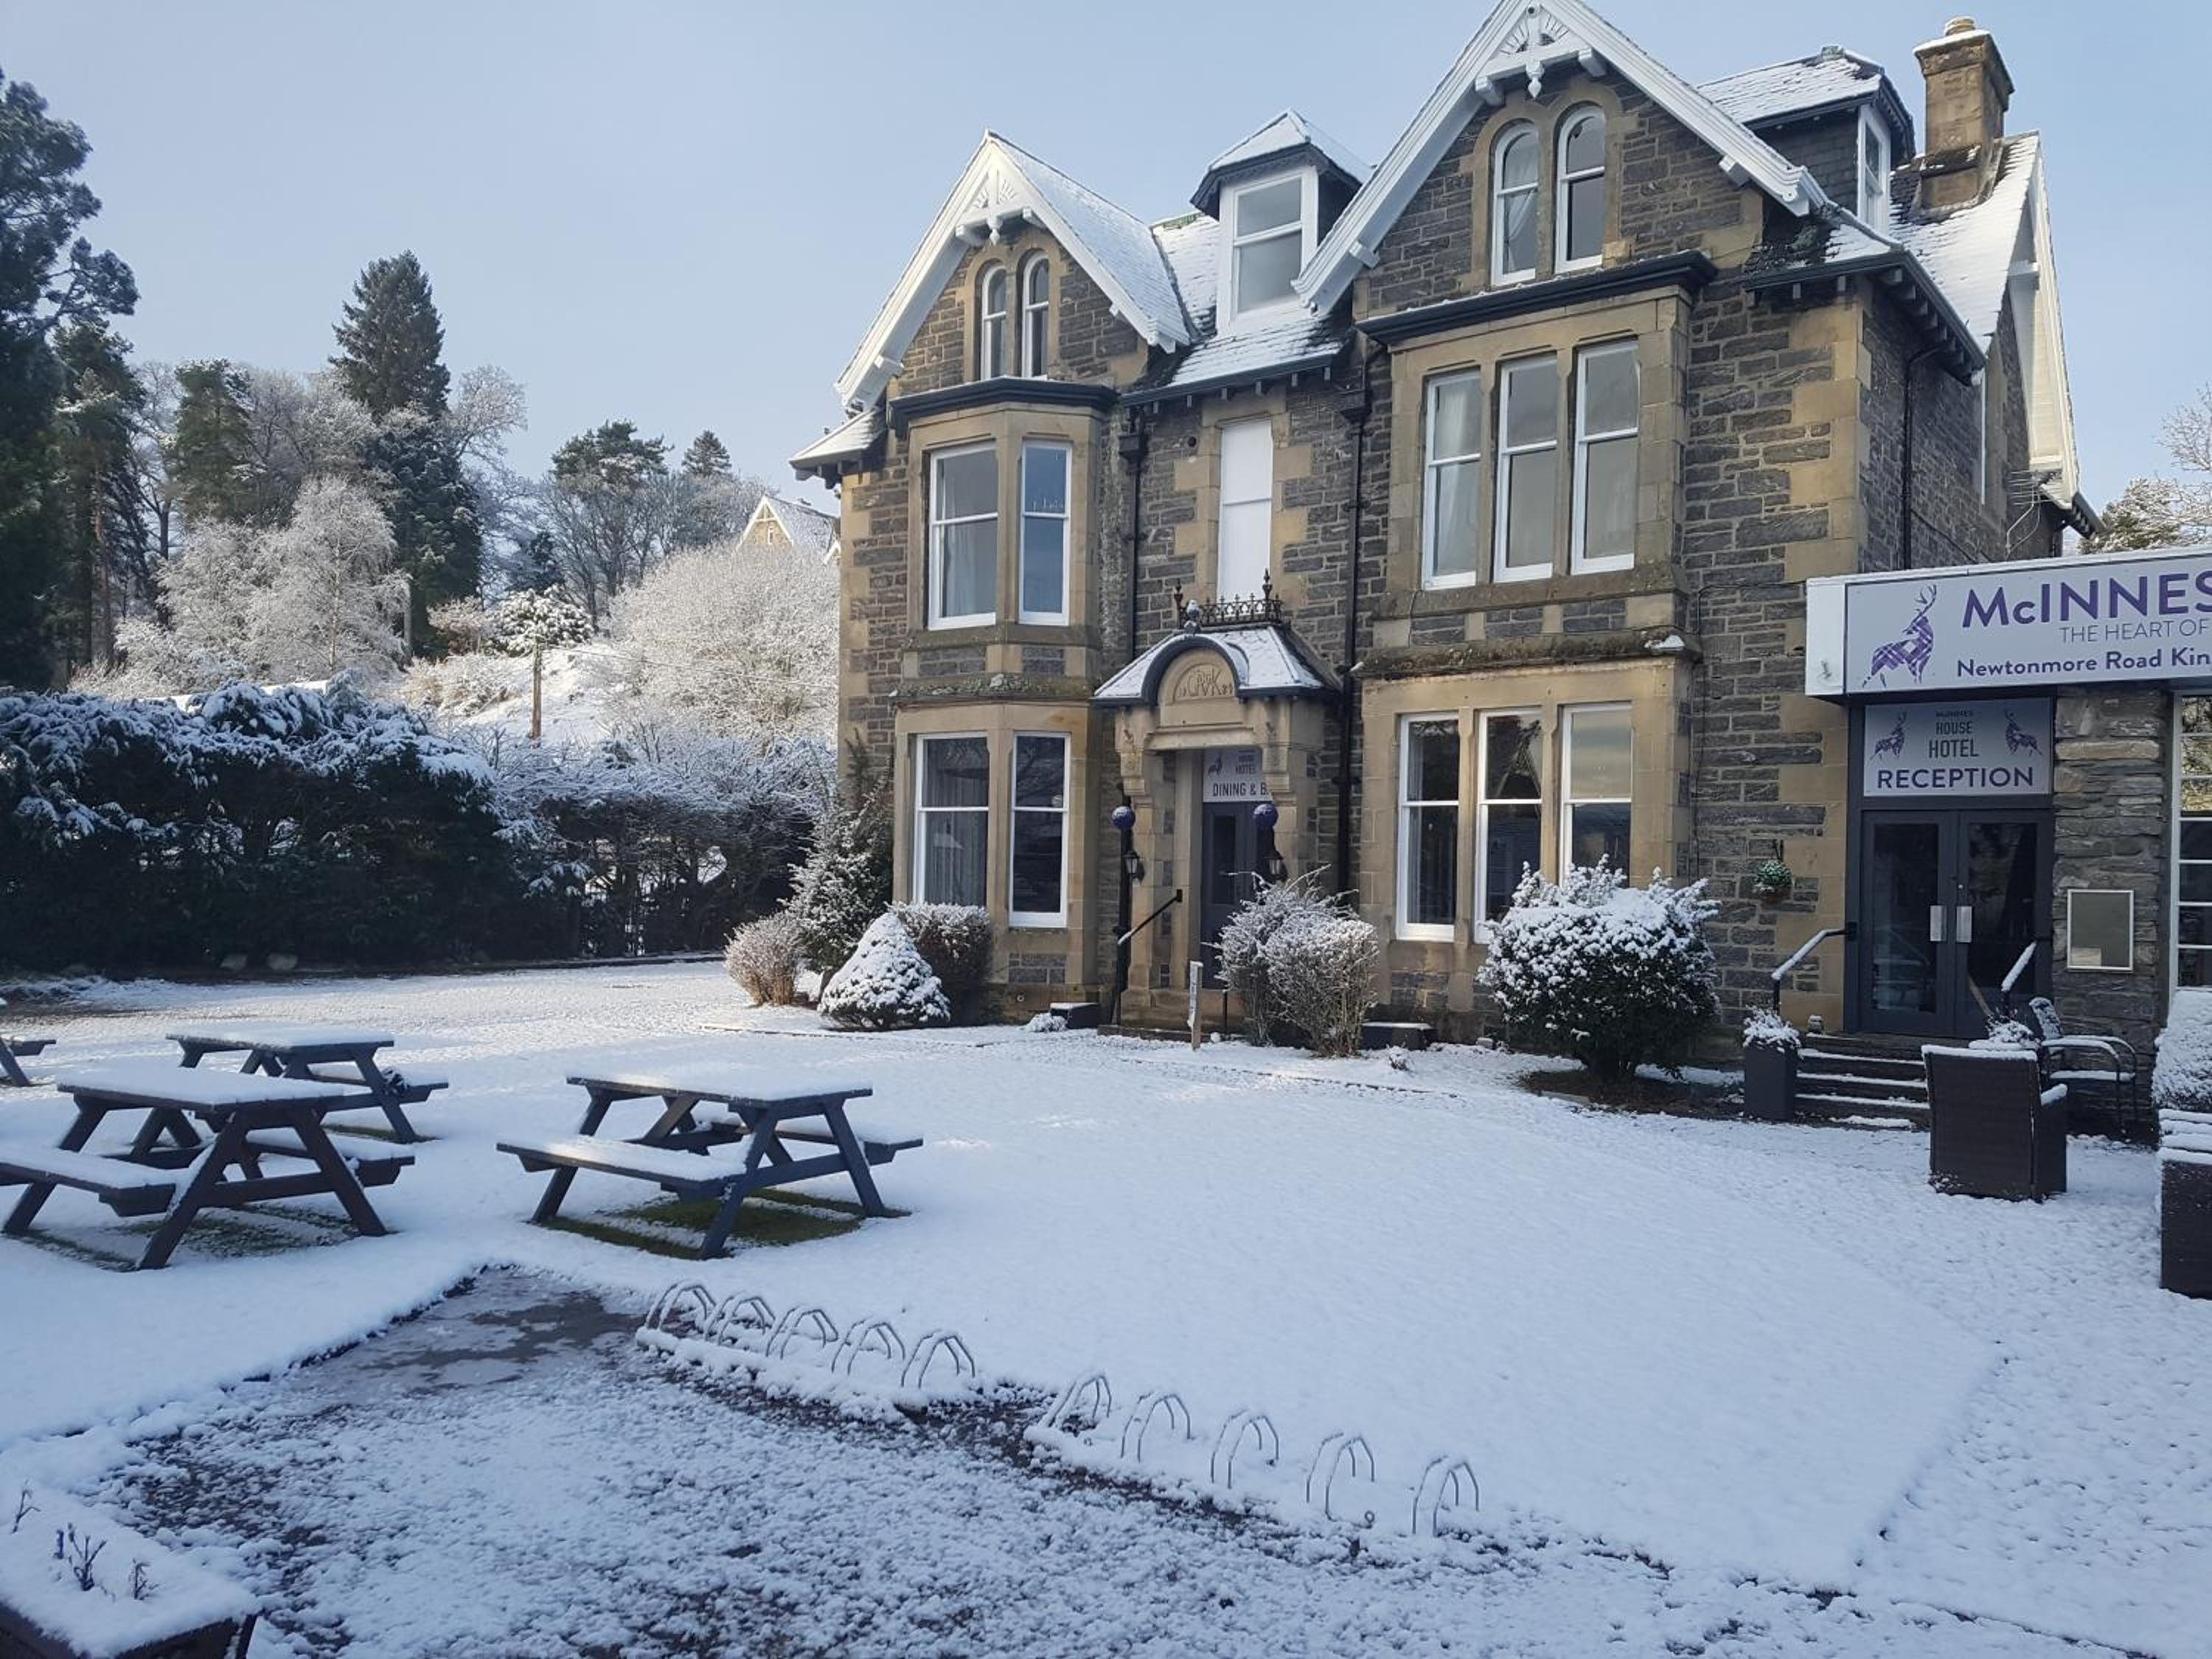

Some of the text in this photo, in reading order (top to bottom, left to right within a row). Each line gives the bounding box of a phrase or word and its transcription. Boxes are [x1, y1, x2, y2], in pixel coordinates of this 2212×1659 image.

[2059, 618, 2208, 643] THE HEART OF
[1958, 658, 2098, 677] Newtonmore
[2106, 648, 2162, 669] Road
[1935, 721, 1973, 734] HOUSE
[1929, 739, 1979, 758] HOTEL
[1877, 767, 2033, 788] RECEPTION
[1213, 782, 1246, 796] DINING
[1251, 783, 1256, 796] &
